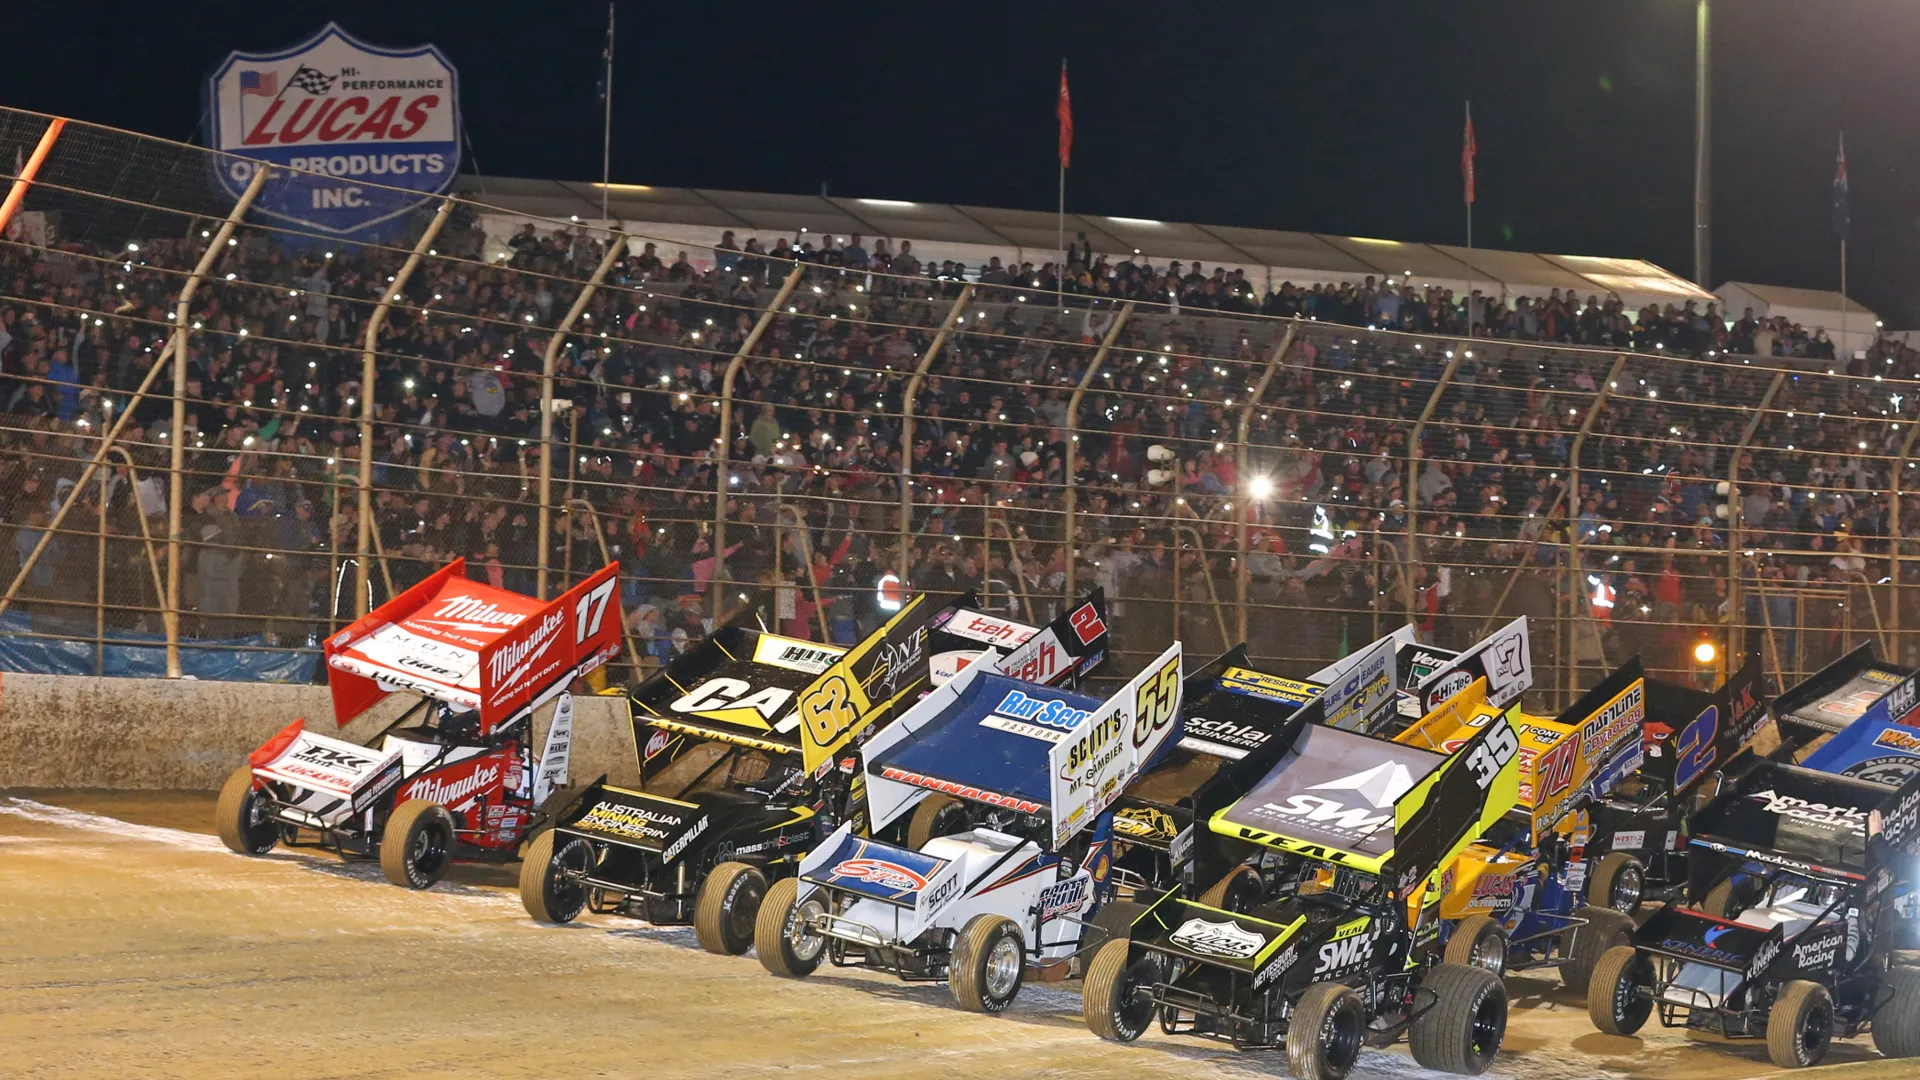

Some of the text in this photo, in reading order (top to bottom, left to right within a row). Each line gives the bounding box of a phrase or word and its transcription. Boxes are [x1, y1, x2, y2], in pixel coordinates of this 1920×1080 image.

[341, 67, 360, 77] HI-
[341, 79, 444, 91] PERFORMANCE
[242, 95, 440, 145] LUCAS
[290, 153, 445, 178] PRODUCTS
[312, 188, 371, 209] INC.
[403, 620, 442, 636] Nothing
[576, 575, 617, 646] 17
[1069, 601, 1107, 646] 2
[486, 609, 564, 688] Milwaukee
[1495, 632, 1525, 677] 7
[1133, 651, 1180, 749] 55
[1440, 674, 1471, 698] Hi-Tec
[802, 676, 862, 747] 62
[999, 692, 1044, 718] RAY
[1001, 721, 1062, 741] PASTORA
[1068, 708, 1121, 773] SCOTT'S
[1086, 741, 1124, 781] GAMBIER
[1465, 715, 1519, 790] 35
[1674, 705, 1718, 796] 2
[282, 764, 330, 781] LUCAS
[403, 763, 499, 804] Milwaukee
[1533, 732, 1580, 811] 70
[881, 767, 1043, 815] HANNAGAN
[572, 820, 646, 839] SERVICES
[588, 808, 649, 827] MINING
[1252, 807, 1378, 842] ENGINEERING
[662, 814, 710, 865] CATERPILLAR
[1239, 827, 1351, 865] VEAL
[927, 873, 959, 910] SCOTT
[1468, 898, 1512, 909] OIL PRODUCTS
[1471, 873, 1517, 898] LUCAS
[1338, 925, 1364, 938] VEAL
[1792, 934, 1843, 959] American
[1253, 942, 1296, 991] HEYTESBURY
[1311, 960, 1370, 983] RACING
[1746, 941, 1782, 982] KENERIC
[1798, 949, 1837, 969] Racing
